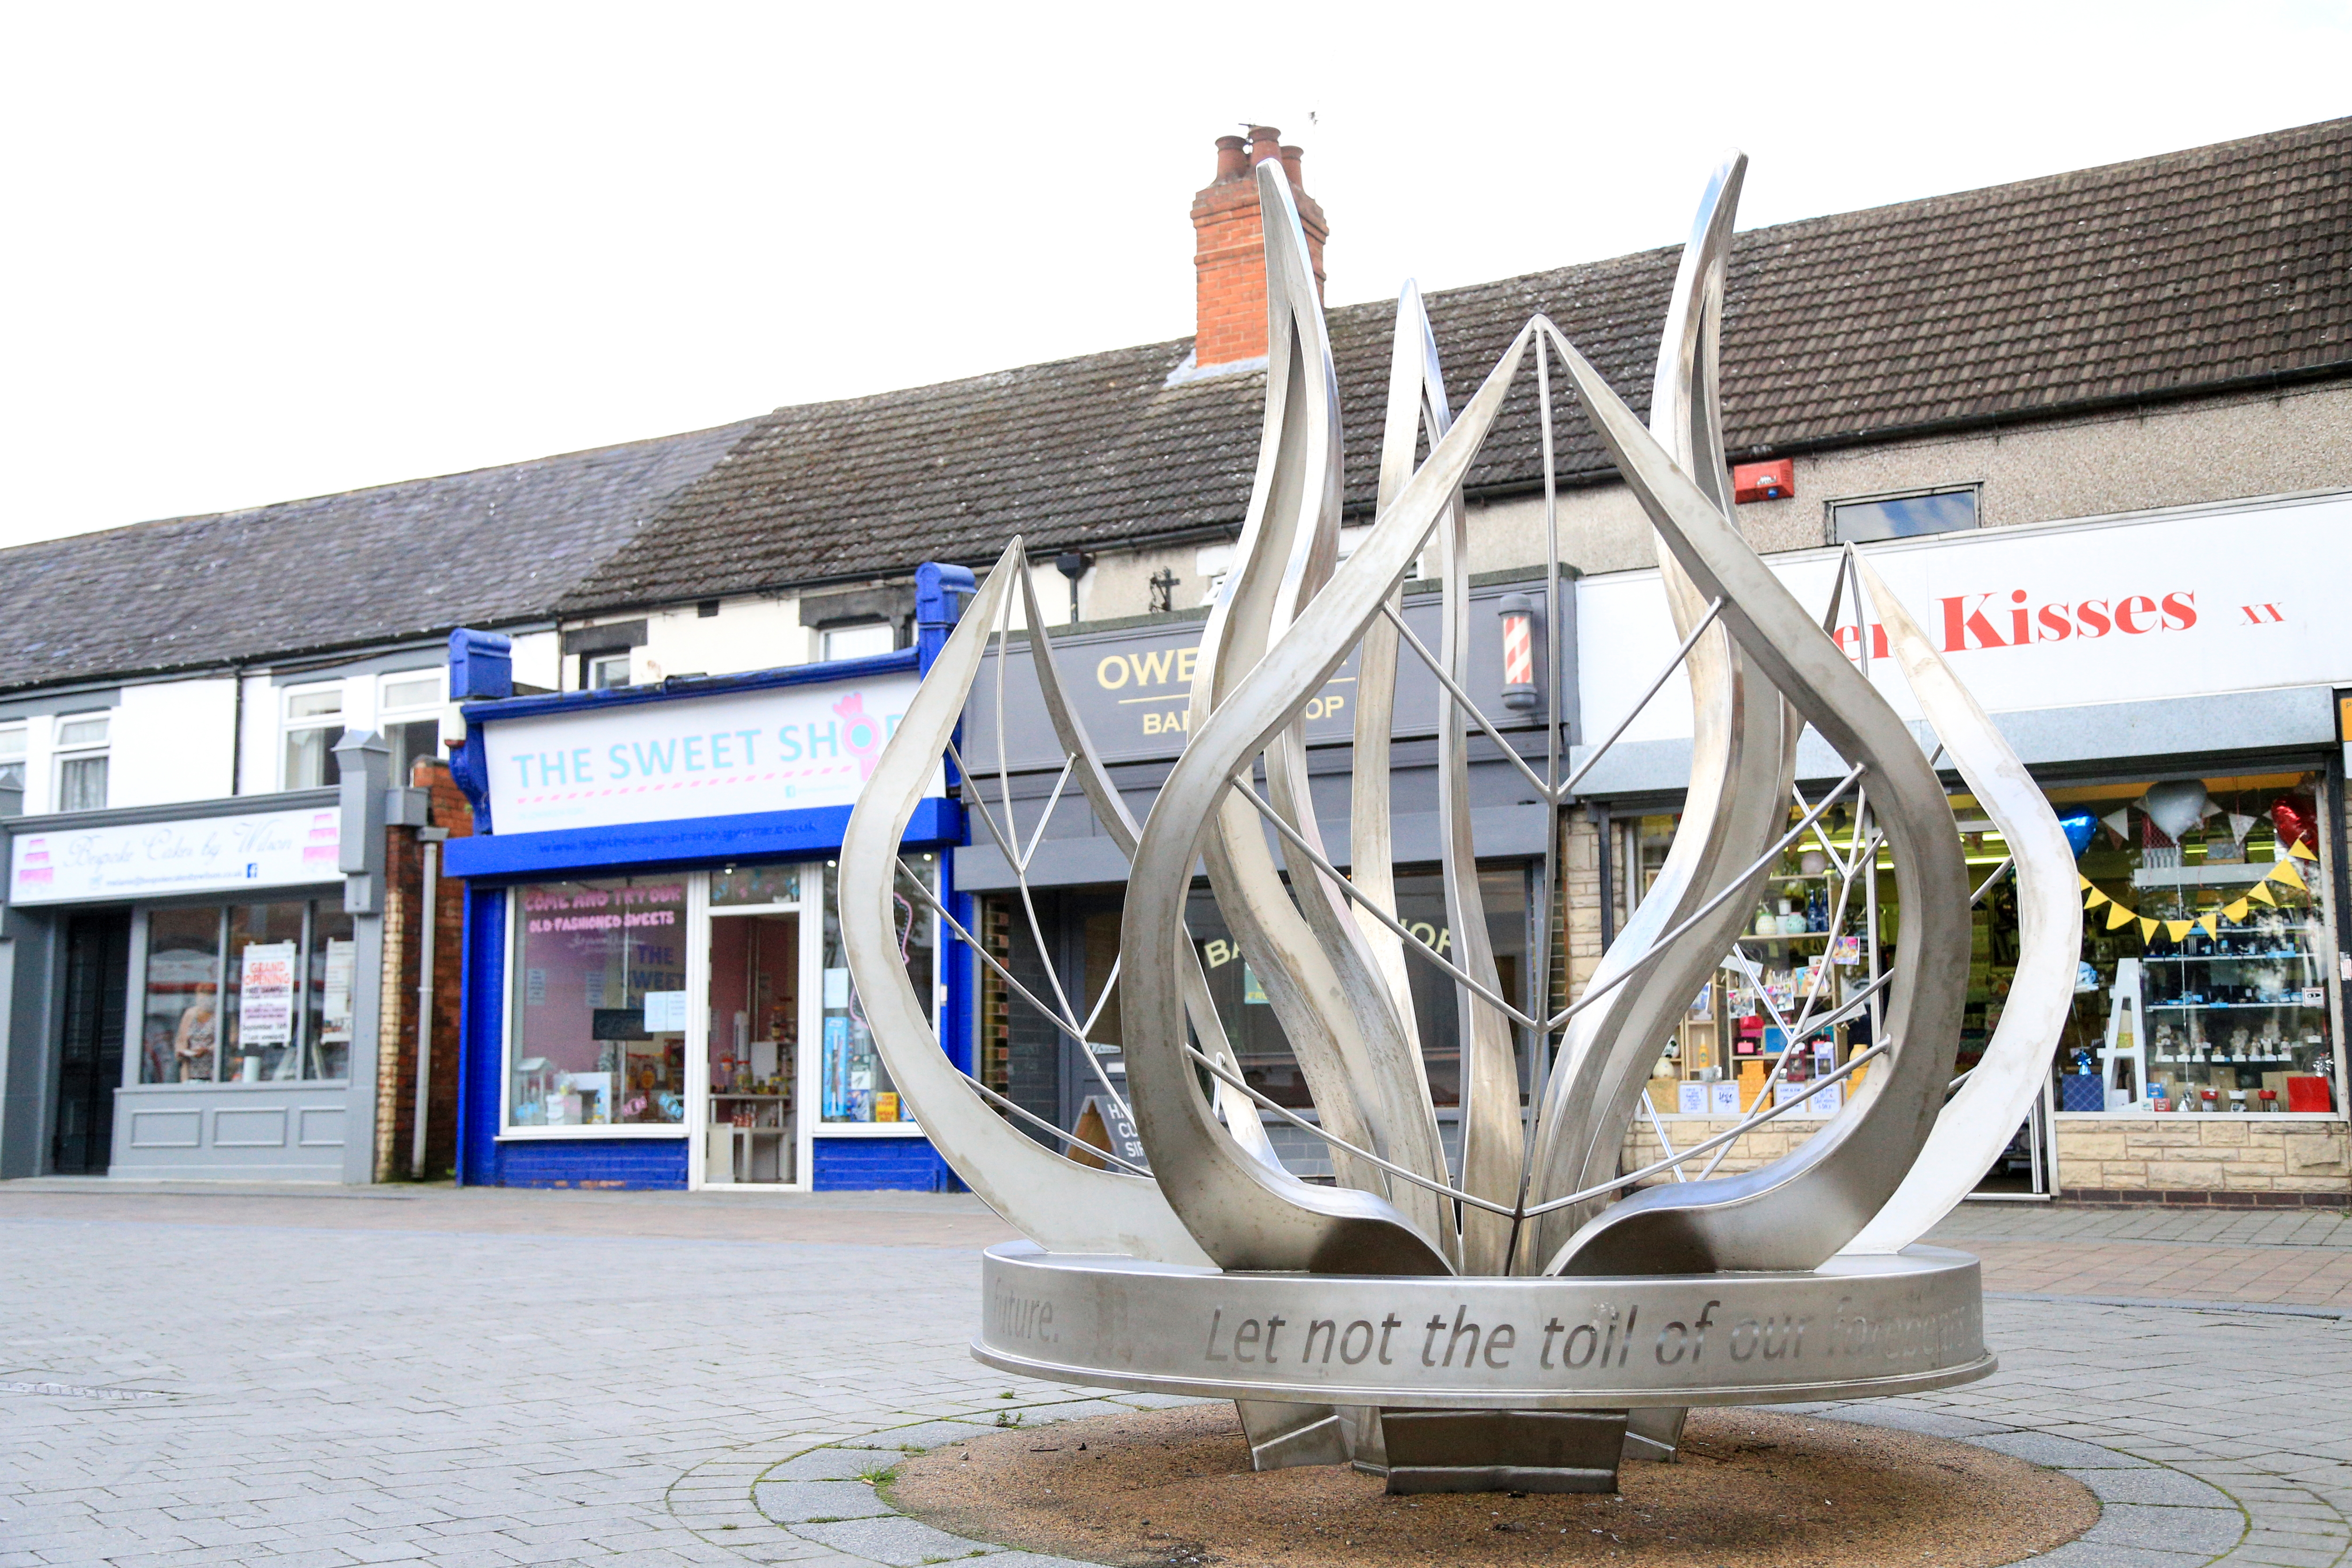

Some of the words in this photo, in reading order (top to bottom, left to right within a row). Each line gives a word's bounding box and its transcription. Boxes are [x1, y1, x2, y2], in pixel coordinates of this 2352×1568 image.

[1832, 623, 1893, 661] er
[1934, 589, 2197, 653] Kisses
[1097, 647, 1199, 690] OWE
[1306, 695, 1349, 719] OP
[511, 748, 594, 788] THE
[608, 729, 762, 779] SWEET
[63, 835, 135, 873] Bespoke
[143, 828, 193, 860] Cakes
[201, 831, 222, 865] by
[233, 819, 293, 853] Wilson
[524, 892, 570, 912] COME
[572, 889, 609, 908] AND
[612, 886, 646, 906] TRY
[649, 883, 682, 904] OUR
[623, 910, 675, 927] SWEETS
[251, 961, 286, 973] GRAND
[637, 945, 674, 965] THE
[244, 972, 291, 986] OPENING
[994, 1277, 1059, 1342] future.
[1205, 1305, 1286, 1364] Let
[1302, 1312, 1402, 1365] not
[1421, 1305, 1516, 1369] the
[1540, 1305, 1638, 1370] toil
[1655, 1300, 1721, 1365] of
[1729, 1316, 1814, 1363] our
